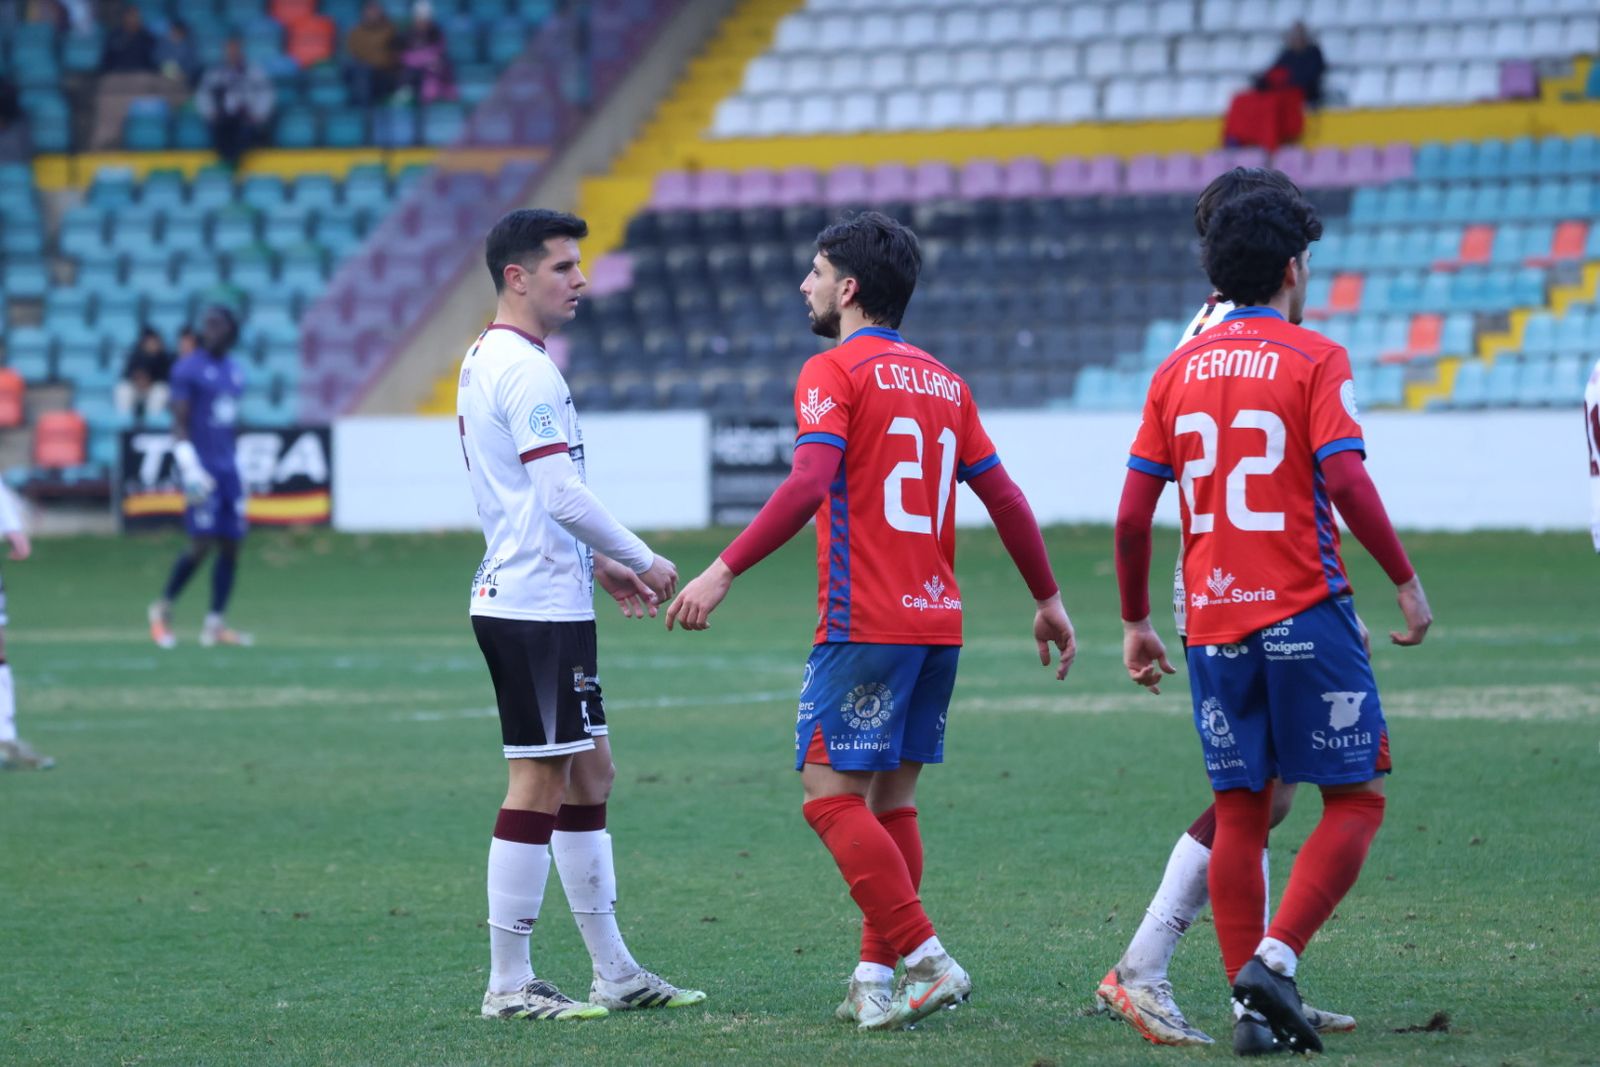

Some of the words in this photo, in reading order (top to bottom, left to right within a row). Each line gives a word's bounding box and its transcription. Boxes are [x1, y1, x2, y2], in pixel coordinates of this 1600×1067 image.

[874, 363, 961, 407] C.DELGADO
[883, 416, 957, 542] 21
[1174, 409, 1286, 534] 22
[902, 594, 928, 611] Caja
[1231, 587, 1276, 603] Soria
[1263, 640, 1315, 655] Oxígeno
[830, 740, 850, 750] Los
[1311, 727, 1372, 750] Soria
